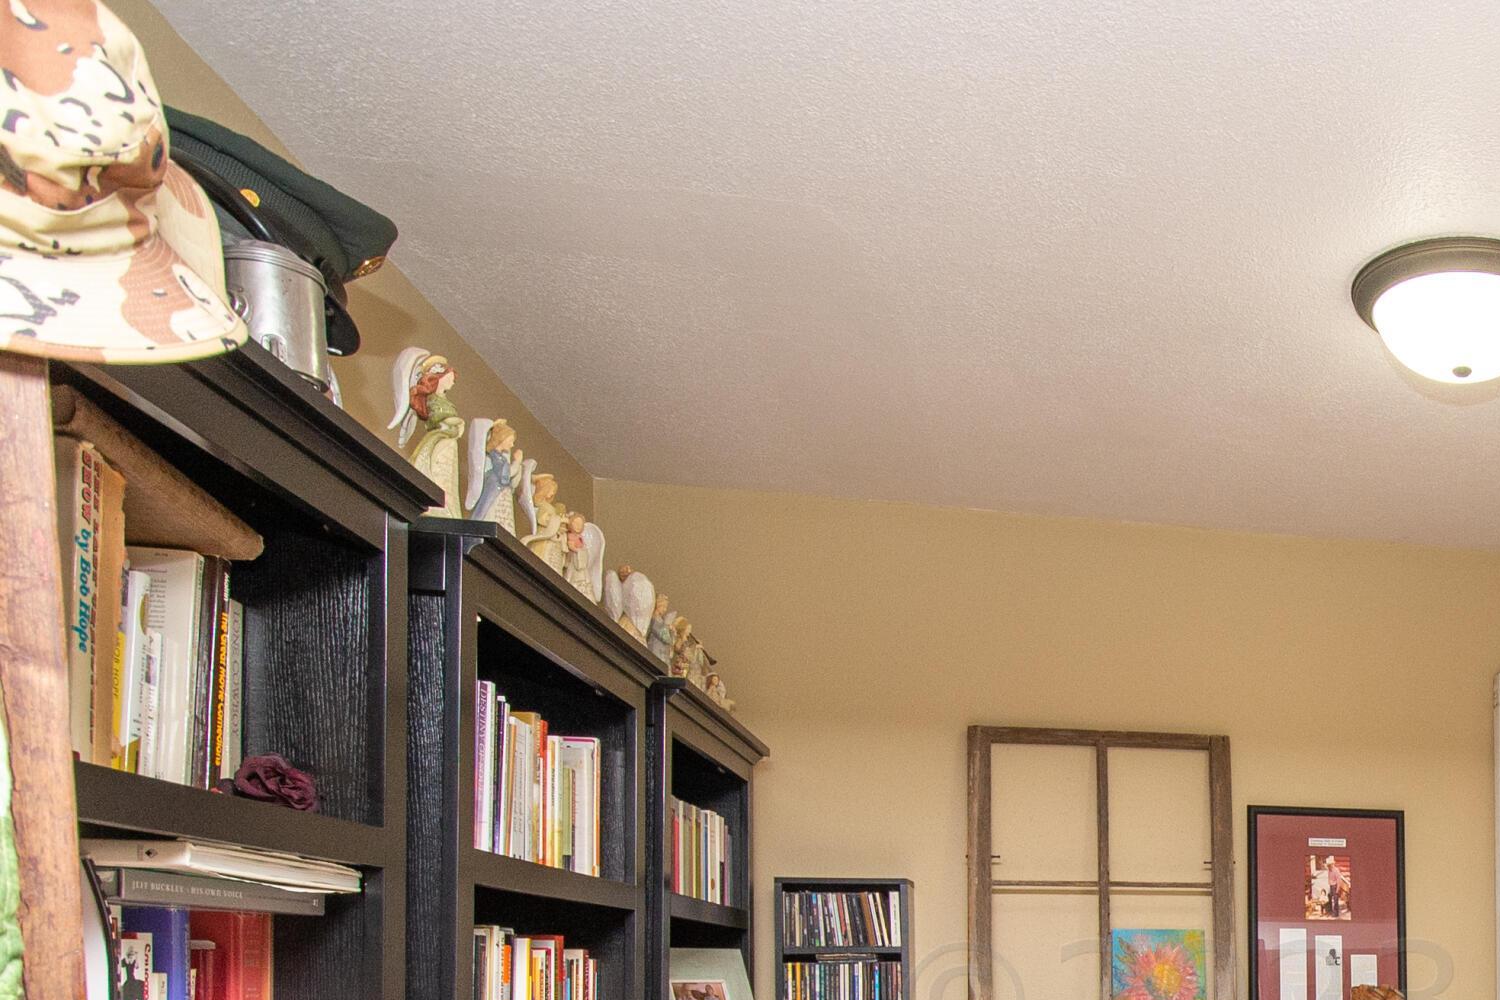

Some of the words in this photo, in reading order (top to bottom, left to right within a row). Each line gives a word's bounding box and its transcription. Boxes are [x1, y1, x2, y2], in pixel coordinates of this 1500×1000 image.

[81, 450, 93, 524] SHOW
[74, 528, 92, 553] by
[80, 555, 92, 597] Bob
[71, 598, 91, 653] Hope
[149, 883, 184, 894] BUCKLEY
